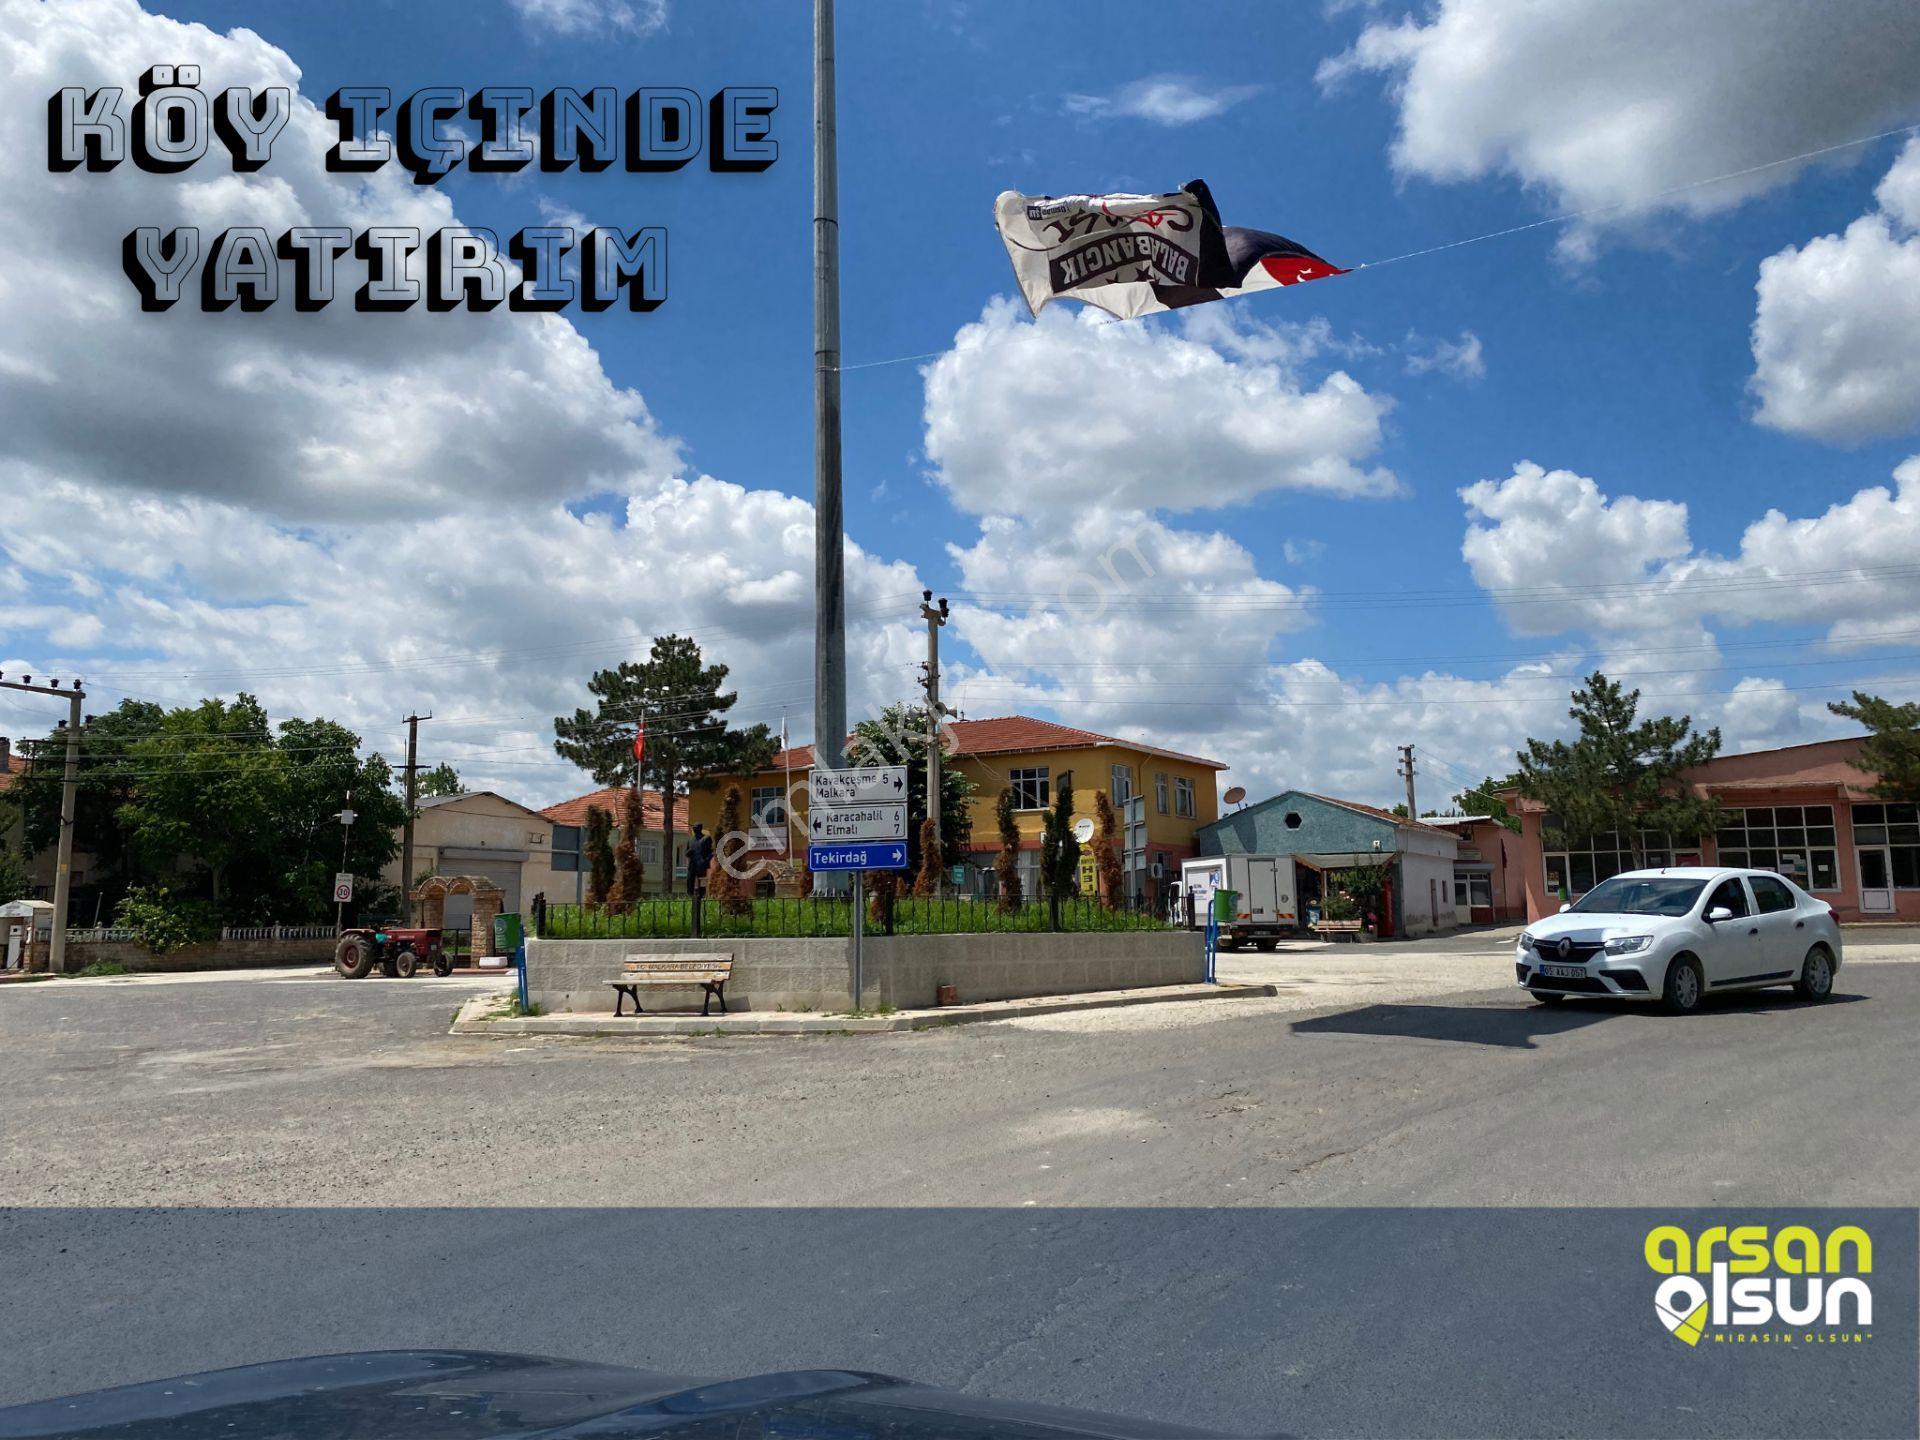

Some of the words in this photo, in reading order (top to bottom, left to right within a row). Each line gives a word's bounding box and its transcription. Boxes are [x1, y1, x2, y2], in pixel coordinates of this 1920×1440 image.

[1059, 235, 1189, 284] BALABANCIK
[882, 773, 889, 785] 5
[816, 787, 856, 799] Malkara
[826, 810, 883, 823] Karacahalil
[894, 810, 900, 821] 6
[826, 823, 858, 836] Elmalı
[894, 823, 900, 834] 7
[813, 850, 867, 866] Tekirdağ
